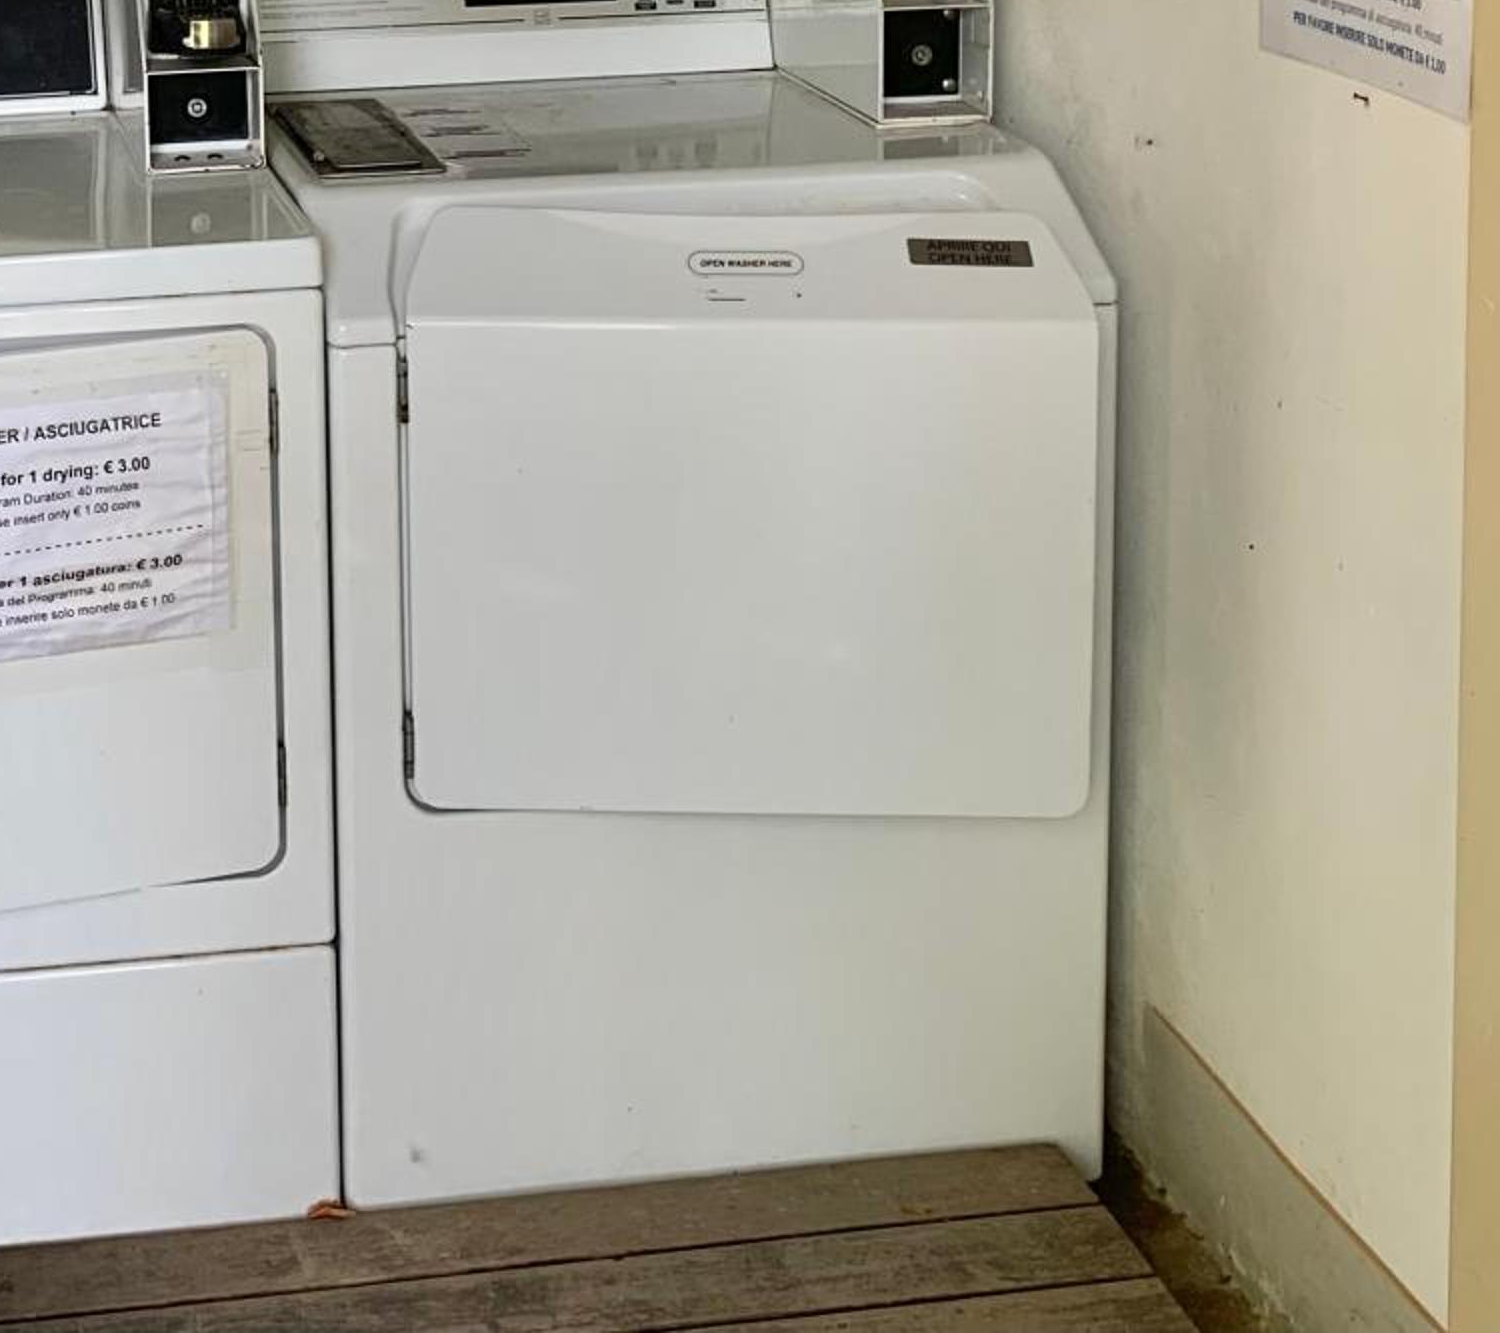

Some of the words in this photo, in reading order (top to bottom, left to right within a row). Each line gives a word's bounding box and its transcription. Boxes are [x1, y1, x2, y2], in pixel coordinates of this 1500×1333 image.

[699, 259, 725, 268] OPEN
[728, 258, 766, 268] WASHER
[767, 259, 792, 268] HERE
[23, 426, 30, 441] /
[34, 412, 162, 441] ASCIUGATRICE
[1, 471, 24, 487] for
[29, 470, 37, 484] 1
[43, 462, 99, 484] drying:
[103, 460, 114, 474] €
[118, 456, 151, 473] 3.00
[77, 485, 92, 497] 40
[95, 481, 140, 495] minutes
[13, 511, 46, 527] insert
[47, 508, 71, 523] only
[73, 505, 81, 516] €
[85, 502, 109, 516] 1.00
[111, 499, 141, 512] coins
[20, 576, 27, 587] 1
[33, 562, 132, 587] asciugatura:
[136, 559, 147, 570] €
[150, 554, 183, 569] 3.00
[7, 595, 25, 607] del
[100, 581, 116, 593] 40
[118, 578, 153, 591] minuti
[5, 611, 48, 626] inserire
[51, 607, 75, 620] solo
[77, 602, 121, 617] monete
[123, 599, 137, 610] da
[140, 597, 148, 607] €
[152, 592, 176, 606] 1.00
